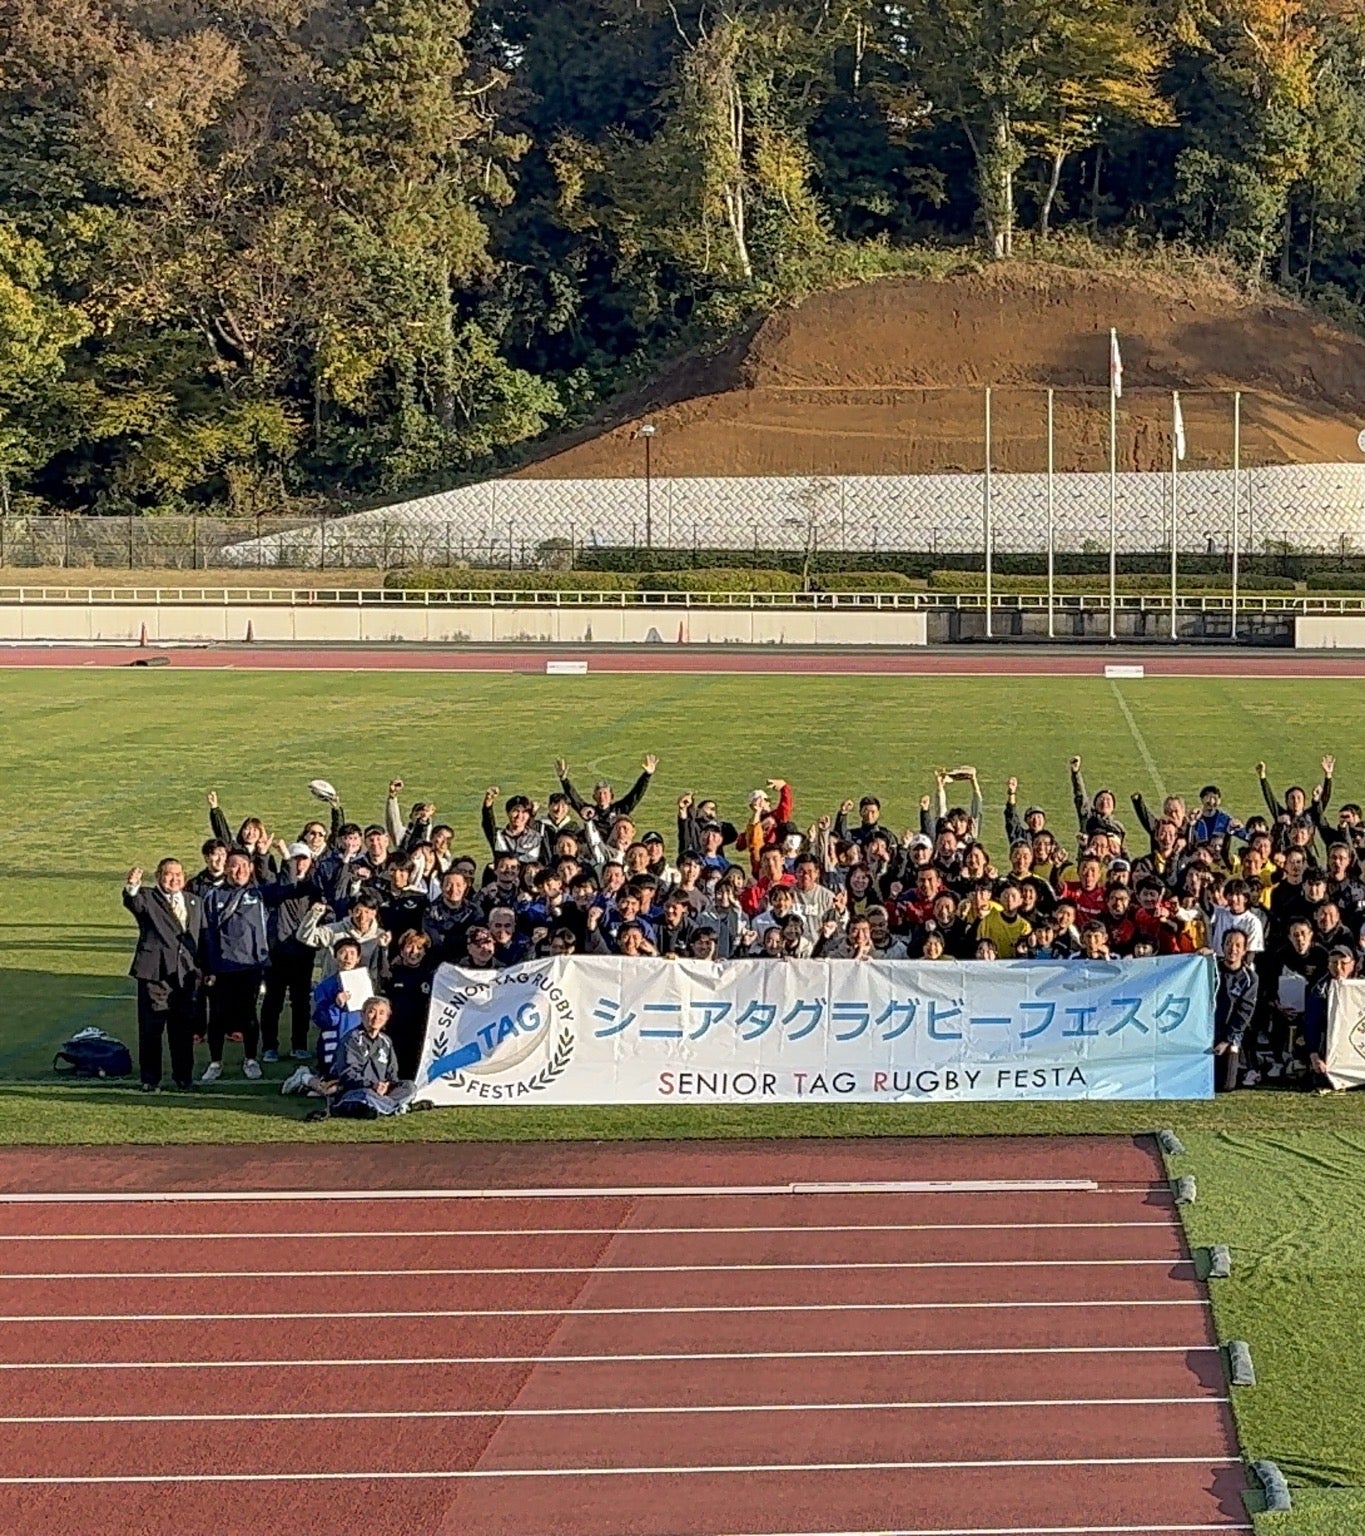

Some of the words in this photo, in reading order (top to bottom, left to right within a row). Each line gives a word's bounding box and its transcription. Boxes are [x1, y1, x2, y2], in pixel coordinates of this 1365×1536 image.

[438, 983, 490, 1028] SENIOR
[495, 973, 530, 985] TAG
[532, 973, 575, 1021] RUGBY
[593, 993, 1192, 1041] シニアタグラグビーフェスタ
[477, 1002, 540, 1050] TAG
[466, 1080, 530, 1099] FESTA
[658, 1072, 776, 1095] SENIOR
[793, 1072, 856, 1096] TAG
[874, 1070, 981, 1093] RUGBY
[997, 1066, 1087, 1089] FESTA
